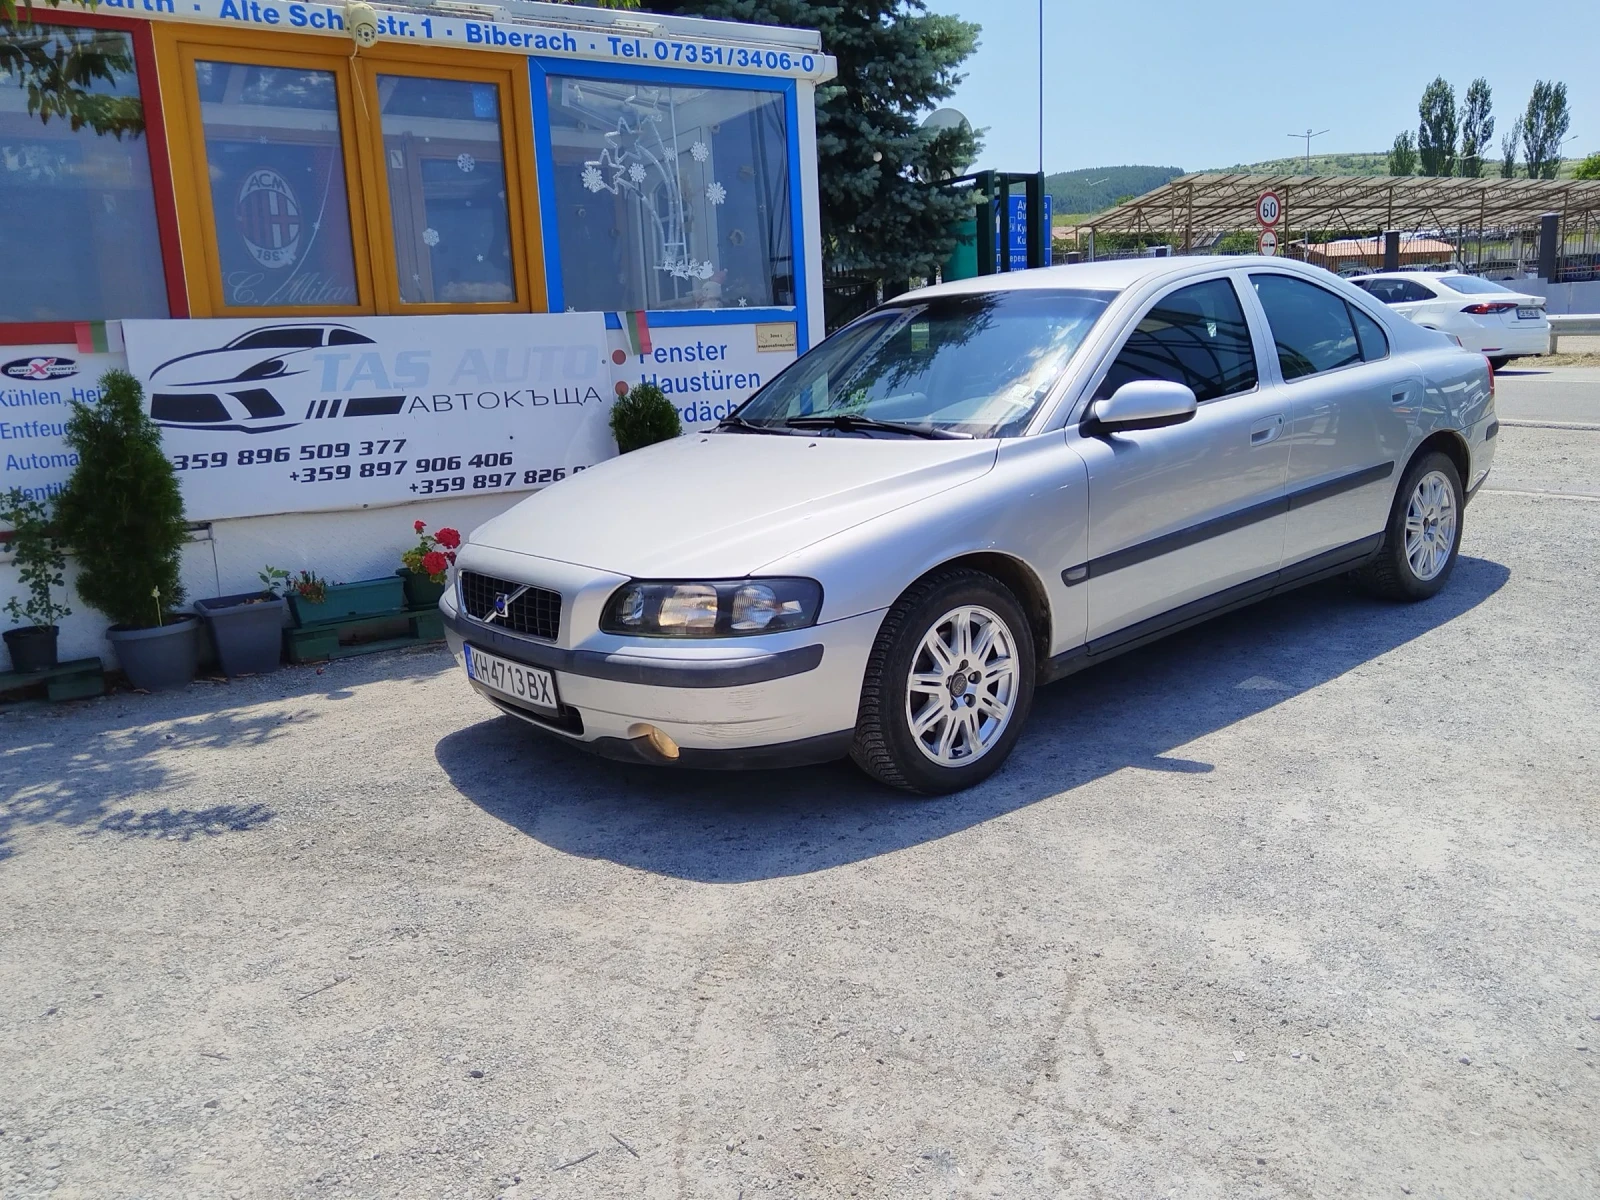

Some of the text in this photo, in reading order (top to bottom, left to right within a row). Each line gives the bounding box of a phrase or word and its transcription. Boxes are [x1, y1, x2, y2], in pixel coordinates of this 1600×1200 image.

[219, 0, 281, 25] Alte
[289, 4, 415, 37] Schstr.
[466, 23, 577, 52] Biberach
[607, 37, 647, 60] Tel.
[655, 41, 814, 73] 07351/3406-0
[247, 173, 286, 194] ACM
[1263, 202, 1276, 217] 60
[313, 344, 599, 392] TAS AUTO
[408, 386, 602, 414] АВТОКЪЩА
[237, 447, 290, 466] 896
[299, 442, 350, 461] 509
[359, 438, 407, 457] 377
[289, 451, 513, 483] +359 897 906 406
[409, 475, 465, 494] +359
[472, 471, 517, 489] 897
[524, 467, 566, 484] 826
